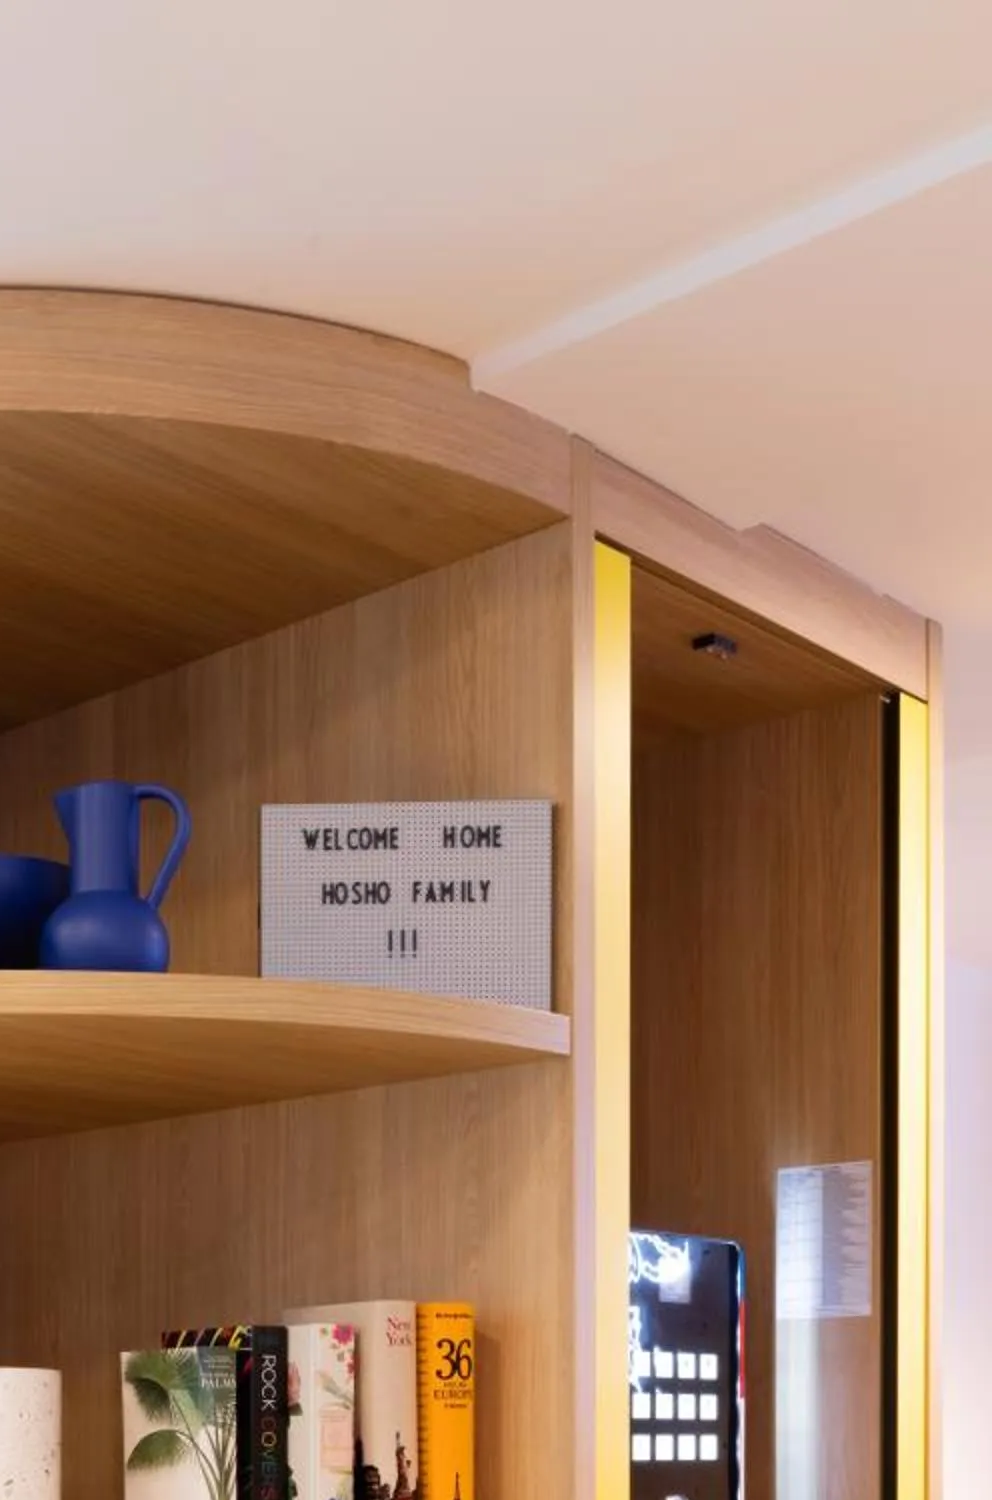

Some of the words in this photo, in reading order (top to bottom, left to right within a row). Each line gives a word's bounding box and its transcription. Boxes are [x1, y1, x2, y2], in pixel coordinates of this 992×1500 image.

[302, 827, 399, 850] WELCOME
[443, 825, 502, 849] HOME
[321, 881, 392, 905] HOSHO
[412, 880, 491, 903] FAMILY
[387, 929, 418, 958] !!!
[435, 1338, 473, 1381] 36
[261, 1355, 277, 1410] ROCK
